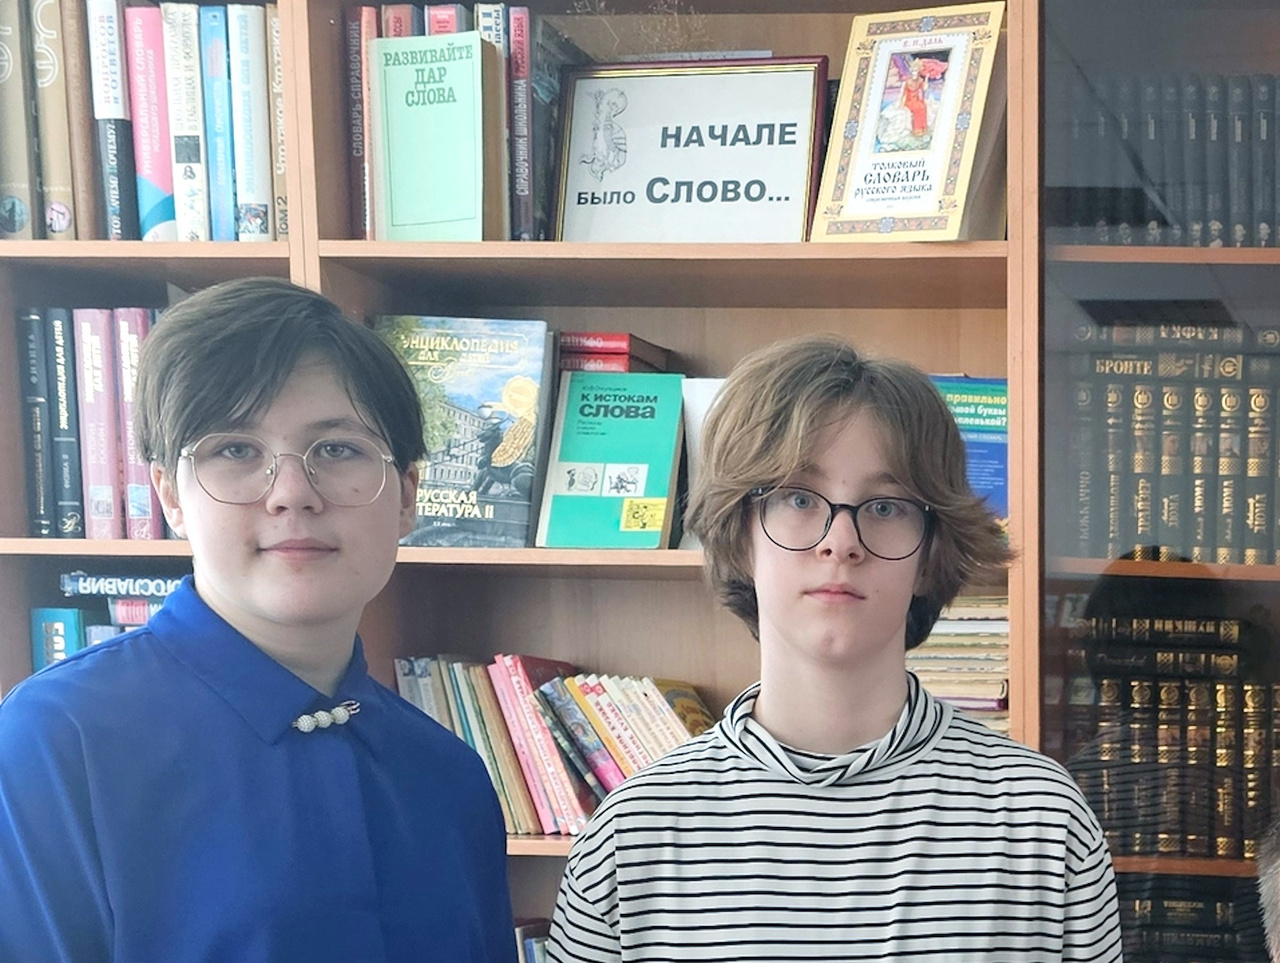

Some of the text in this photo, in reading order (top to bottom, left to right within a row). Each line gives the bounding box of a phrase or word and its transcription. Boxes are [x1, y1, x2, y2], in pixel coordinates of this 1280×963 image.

[98, 14, 111, 104] ВОПРОСОВ
[383, 43, 473, 67] РАЗВИВАЙТЕ
[415, 67, 447, 91] ДАР
[132, 17, 153, 176] УНИВЕРСАЛЬНЫЙ СЛОВАРЬ
[405, 87, 457, 108] СЛОВА
[512, 79, 528, 136] ШКОЛЬНИКА
[660, 122, 798, 149] НАЧАЛЕ
[514, 138, 529, 195] СПРАВОЧНИК
[401, 334, 519, 354] ЭНЦИКЛОПЕДИЯ
[1095, 359, 1153, 375] БРОНТЕ
[594, 393, 659, 404] истокам
[945, 393, 1008, 405] правильно
[578, 403, 657, 419] слова
[976, 405, 1007, 417] буквы
[954, 416, 1007, 427] аленькой?
[416, 488, 477, 504] РУССКАЯ
[416, 502, 482, 519] ТЕРАТУРА
